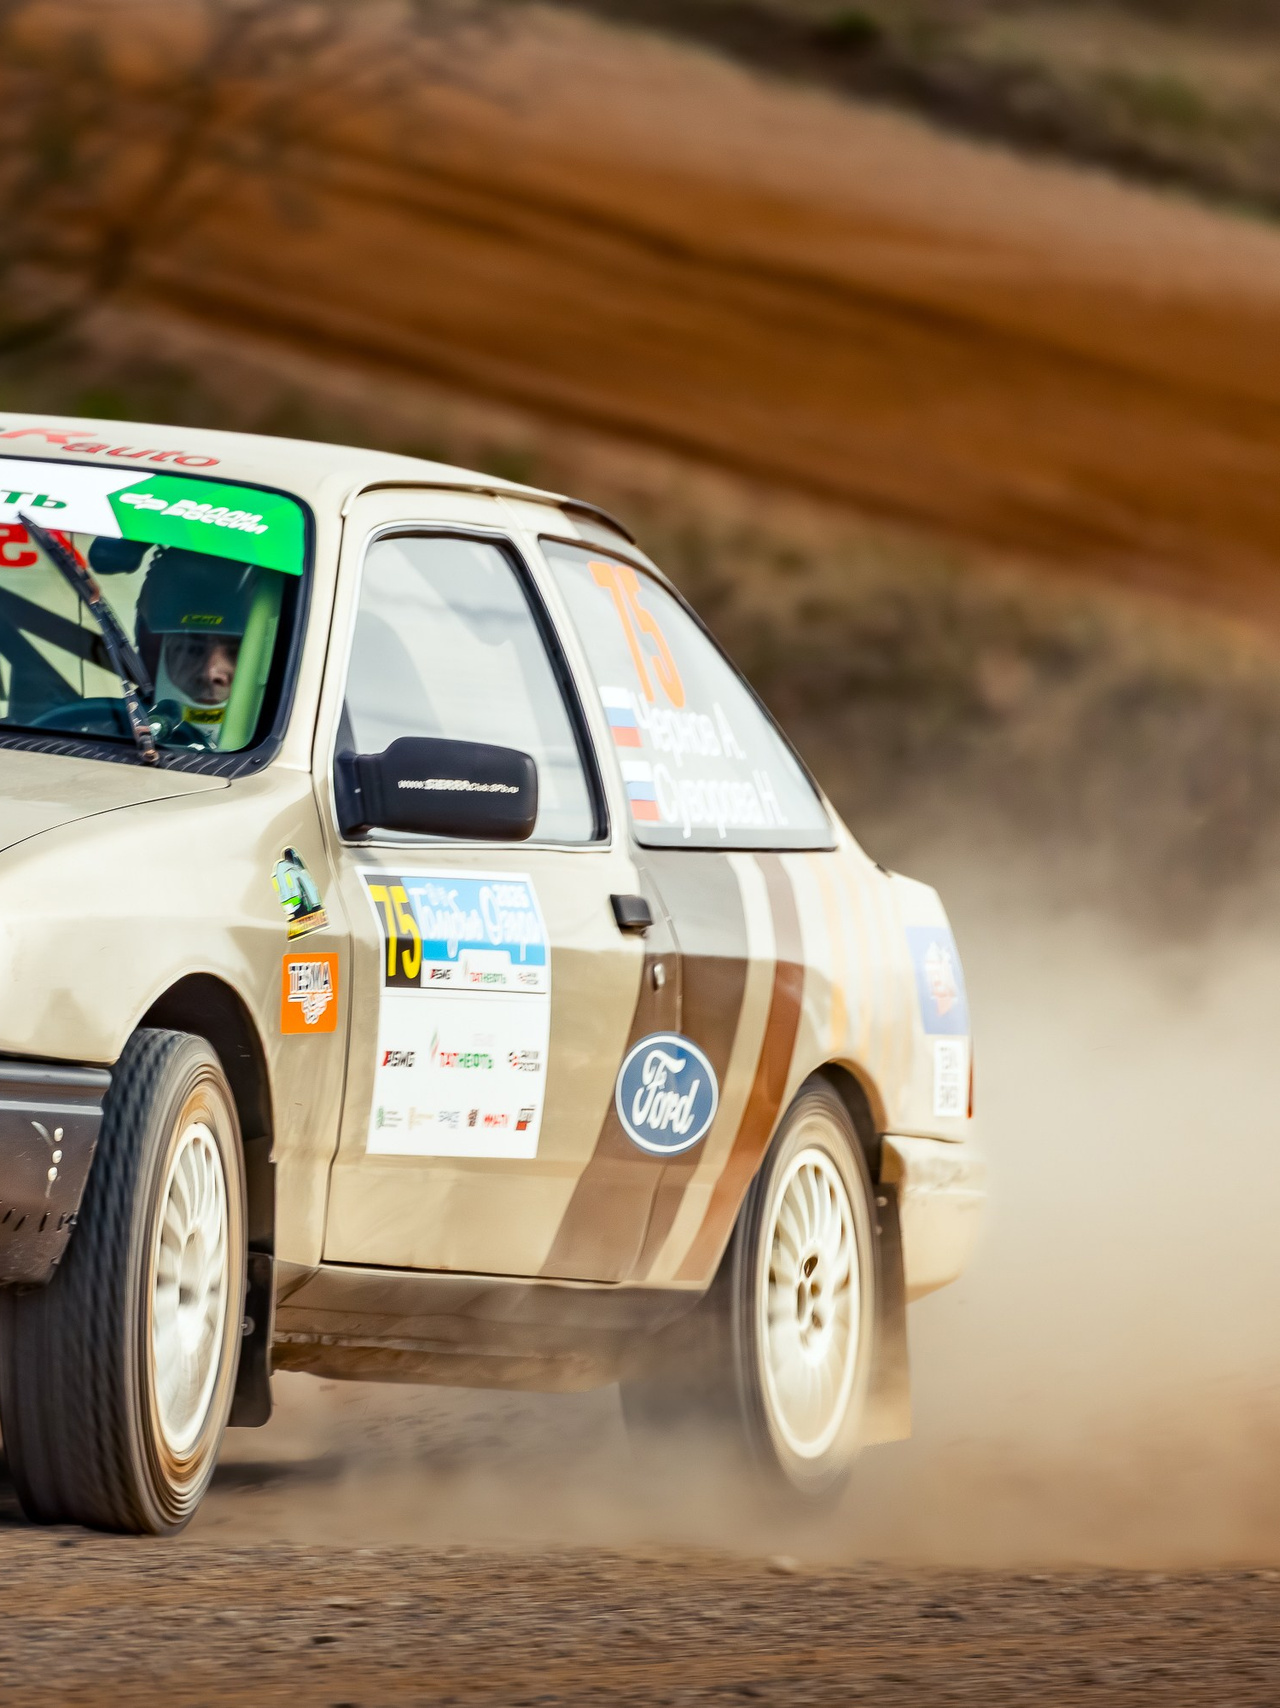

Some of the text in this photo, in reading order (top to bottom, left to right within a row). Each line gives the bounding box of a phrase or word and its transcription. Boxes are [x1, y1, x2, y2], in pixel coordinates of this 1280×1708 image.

[587, 561, 686, 708] 75
[652, 763, 763, 838] Суворова
[368, 884, 422, 979] 75
[632, 1049, 700, 1134] Ford
